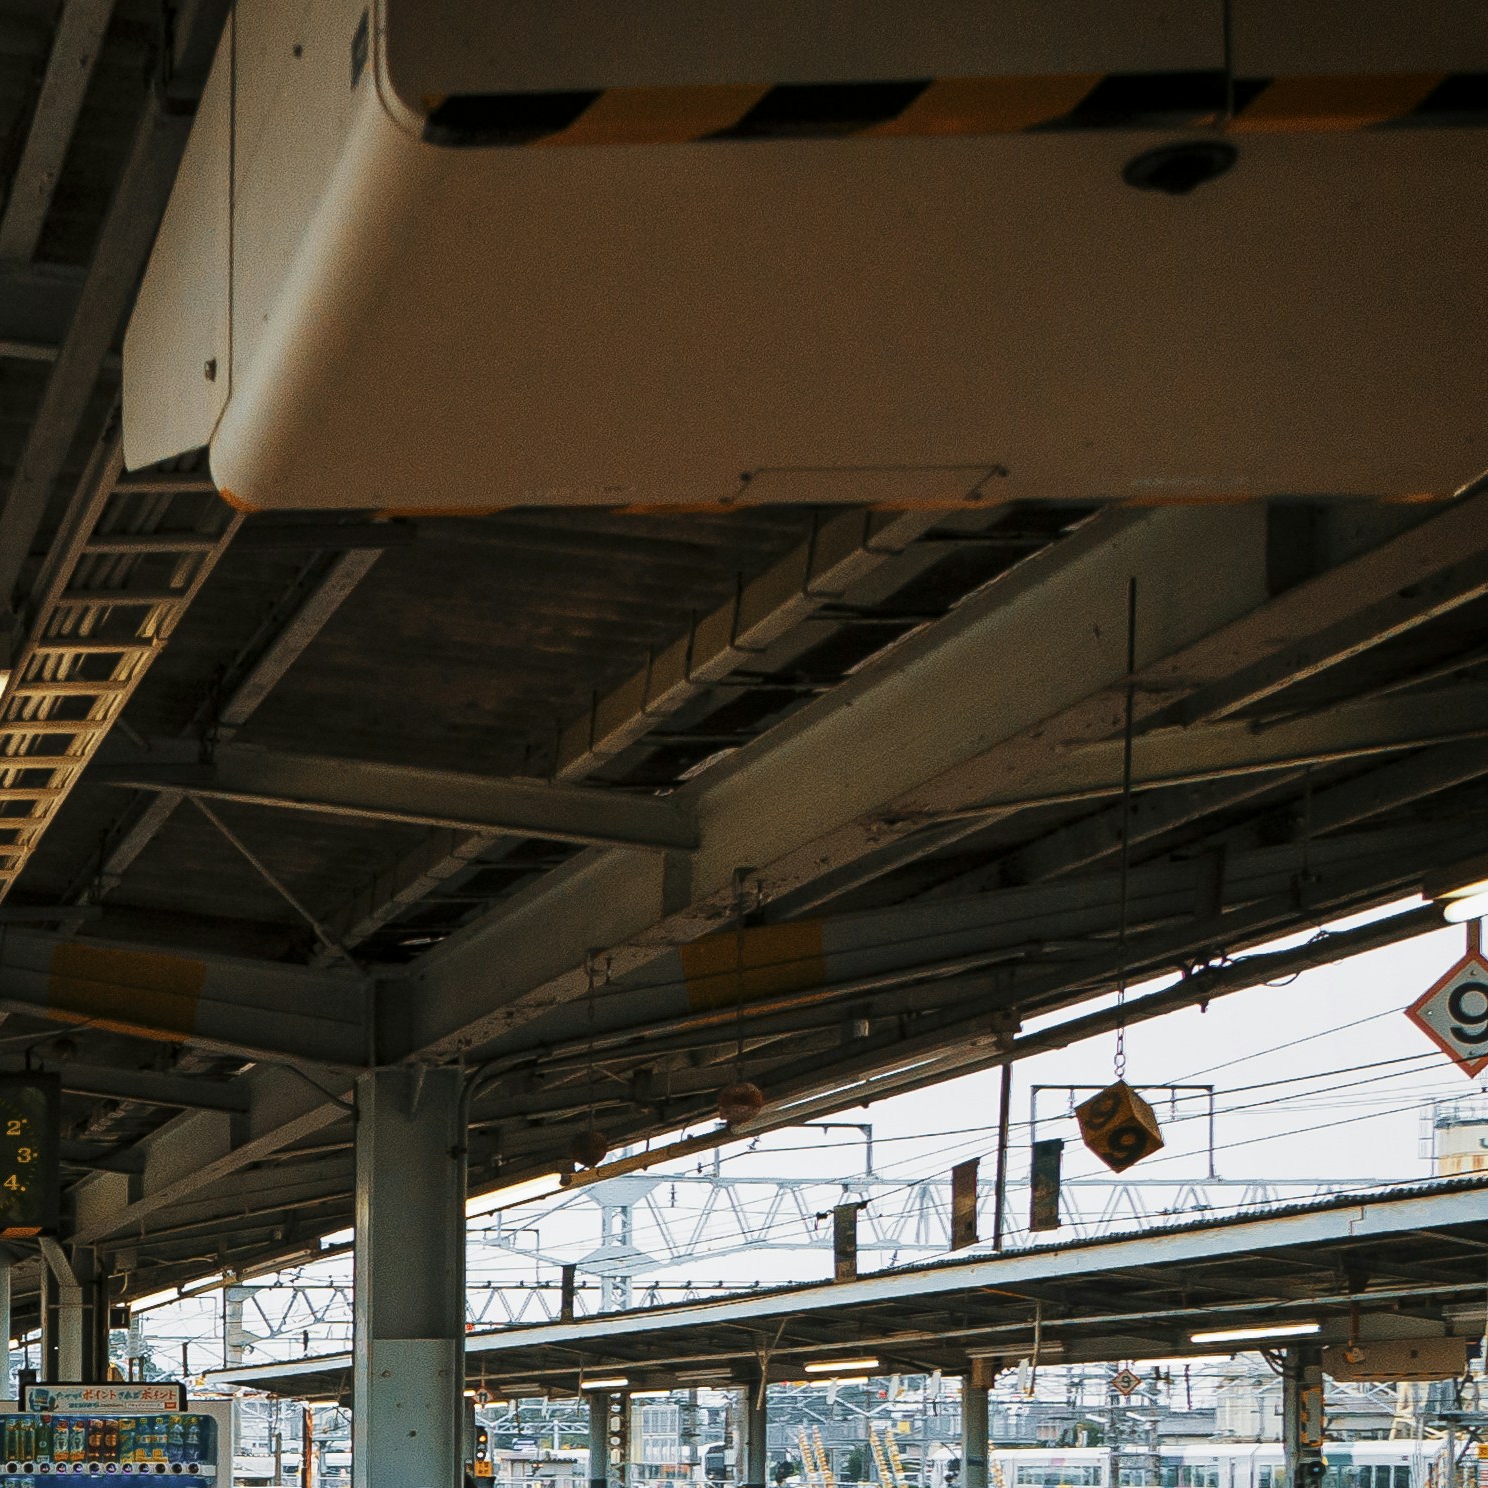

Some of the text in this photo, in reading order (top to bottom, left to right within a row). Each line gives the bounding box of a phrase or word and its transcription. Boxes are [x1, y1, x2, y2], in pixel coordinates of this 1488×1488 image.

[1447, 981, 1488, 1044] 9
[6, 1120, 21, 1136] 2
[17, 1147, 32, 1163] 3
[4, 1174, 20, 1191] 4
